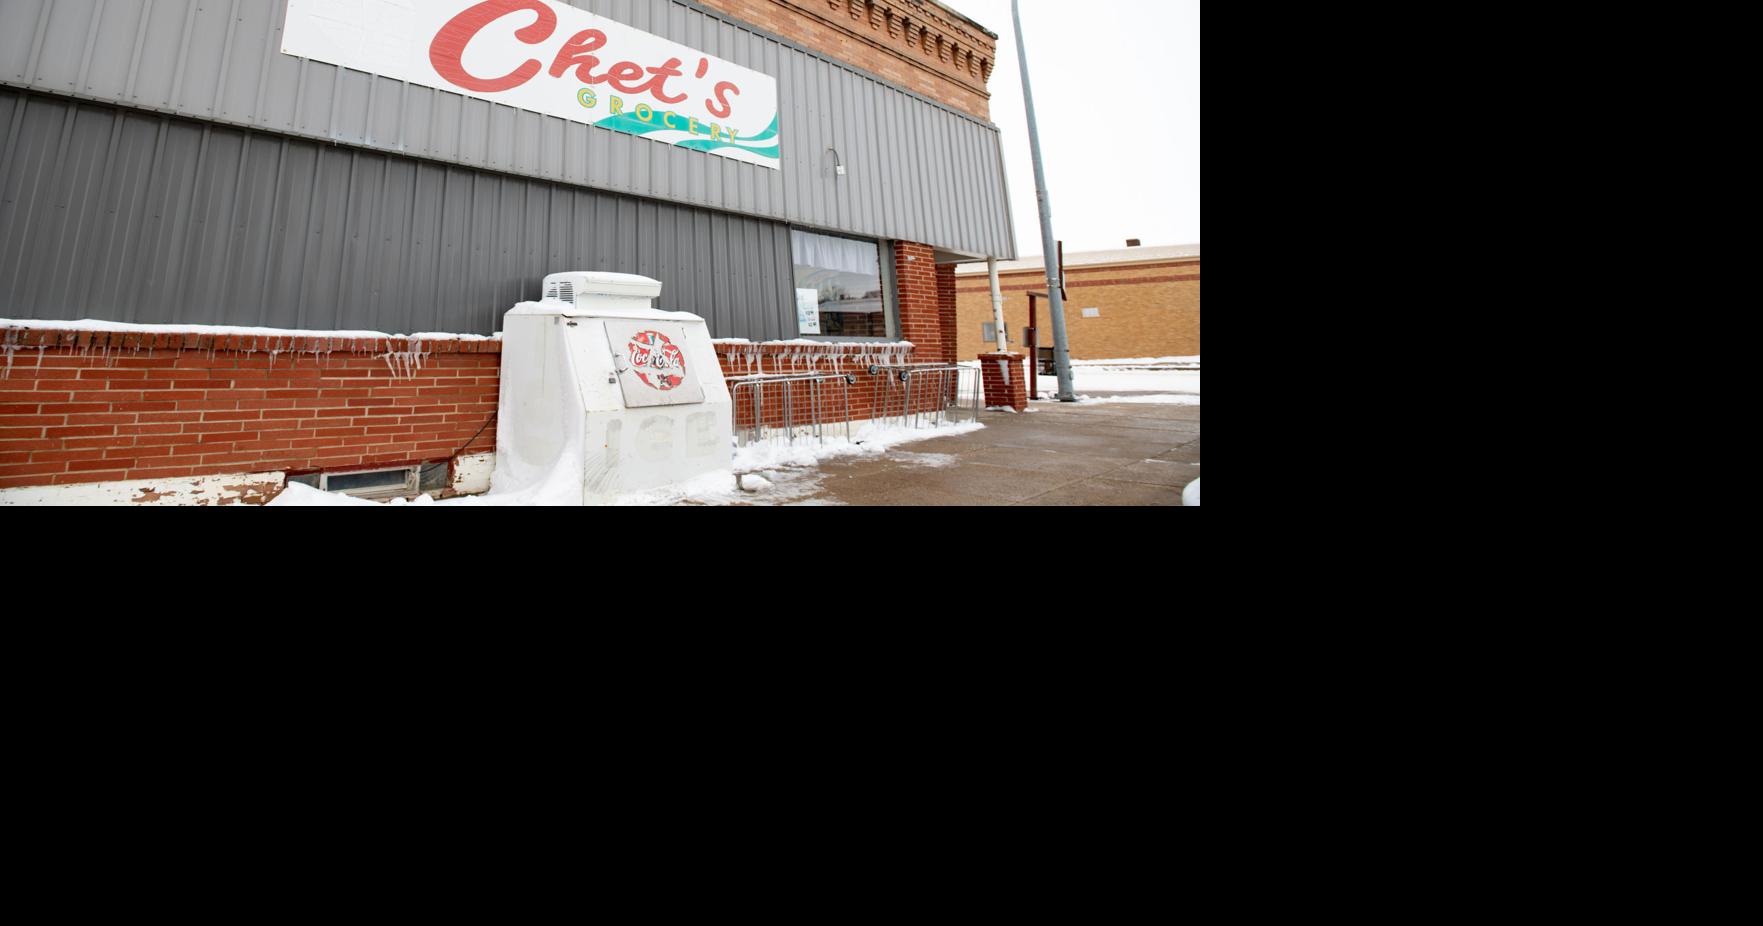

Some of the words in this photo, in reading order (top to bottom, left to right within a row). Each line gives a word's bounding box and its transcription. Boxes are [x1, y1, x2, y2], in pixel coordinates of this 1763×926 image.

[429, 0, 740, 119] Chet's
[577, 88, 739, 144] GROCERY
[606, 411, 721, 468] ICE
